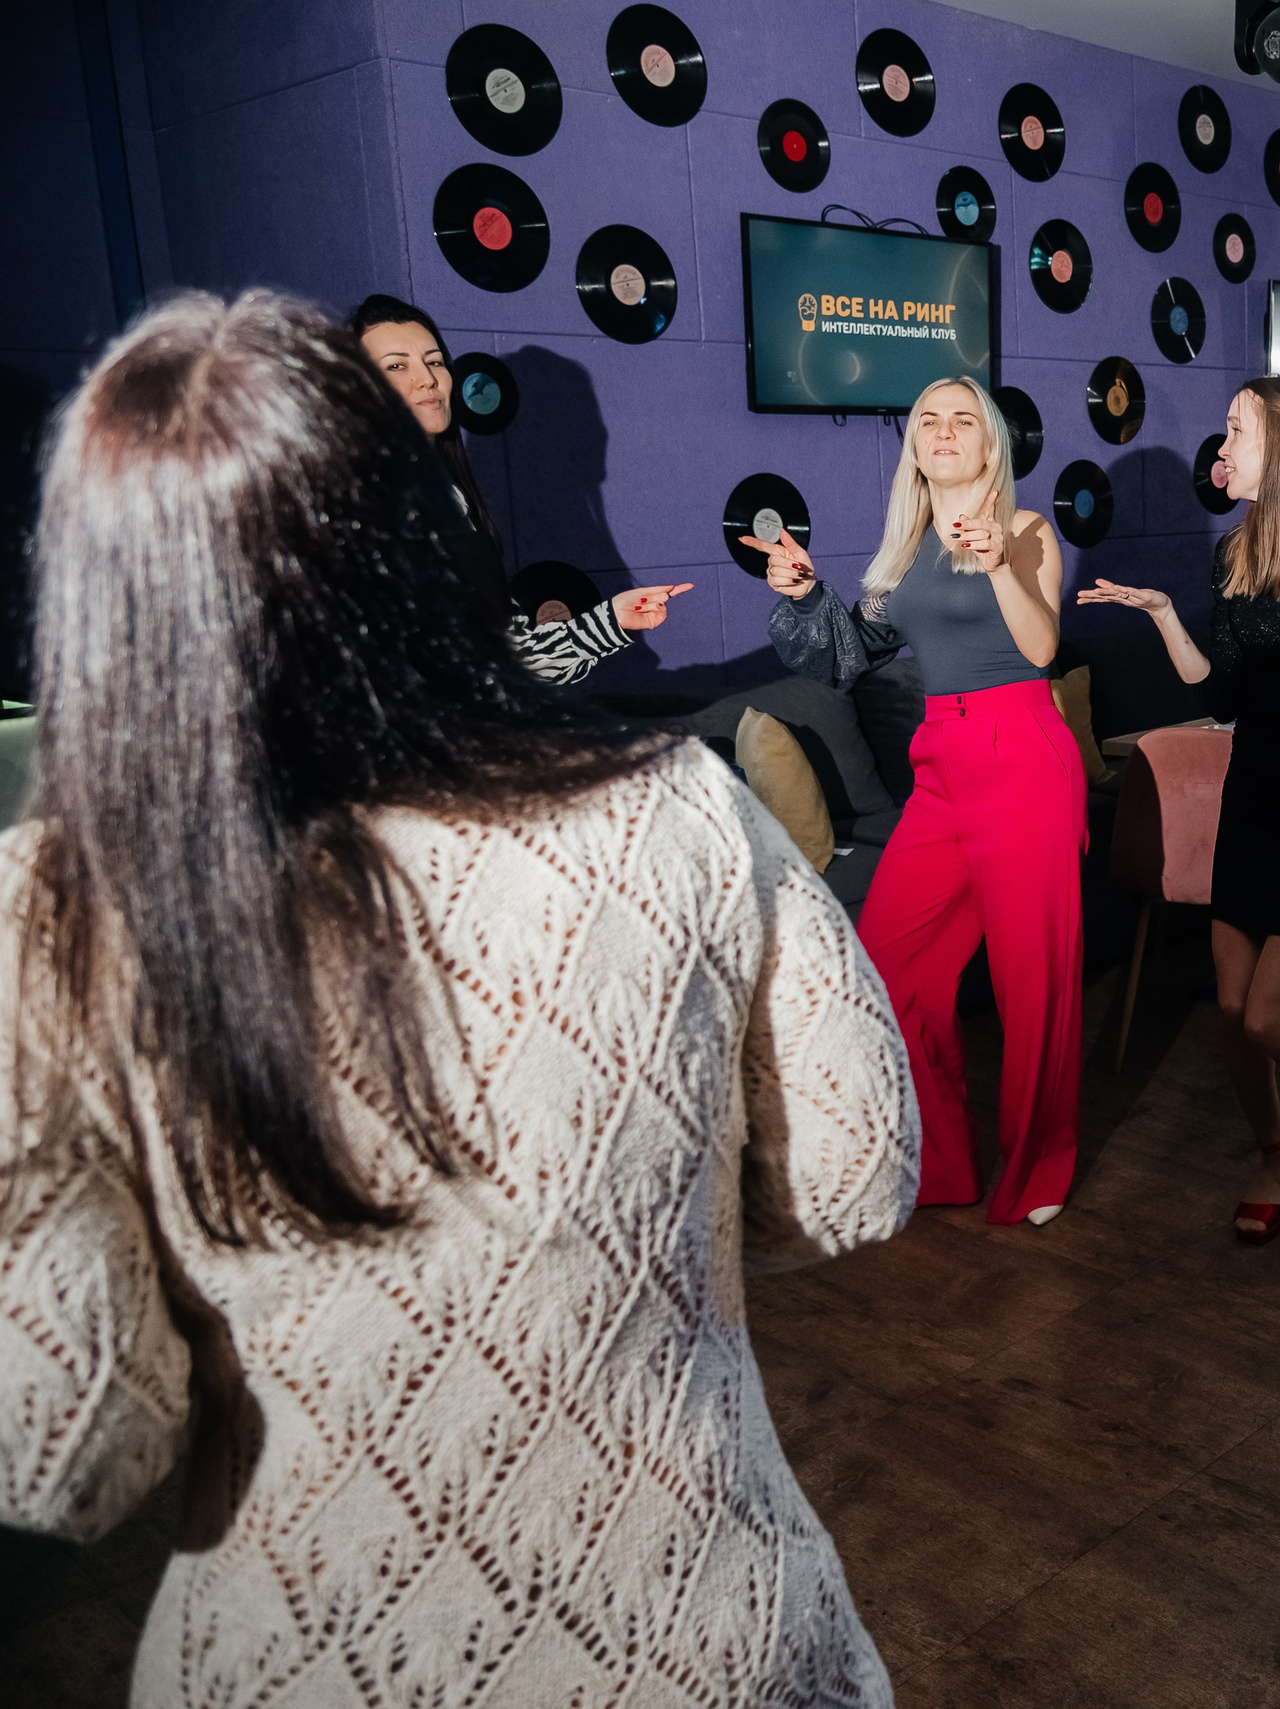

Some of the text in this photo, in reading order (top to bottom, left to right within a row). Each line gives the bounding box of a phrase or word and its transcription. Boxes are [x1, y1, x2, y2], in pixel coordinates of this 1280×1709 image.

[821, 294, 957, 324] ВСЕ НА РИНГ
[821, 321, 957, 341] ИНТЕЛЛЕКТУАЛЬНЫЙ КЛУБ
